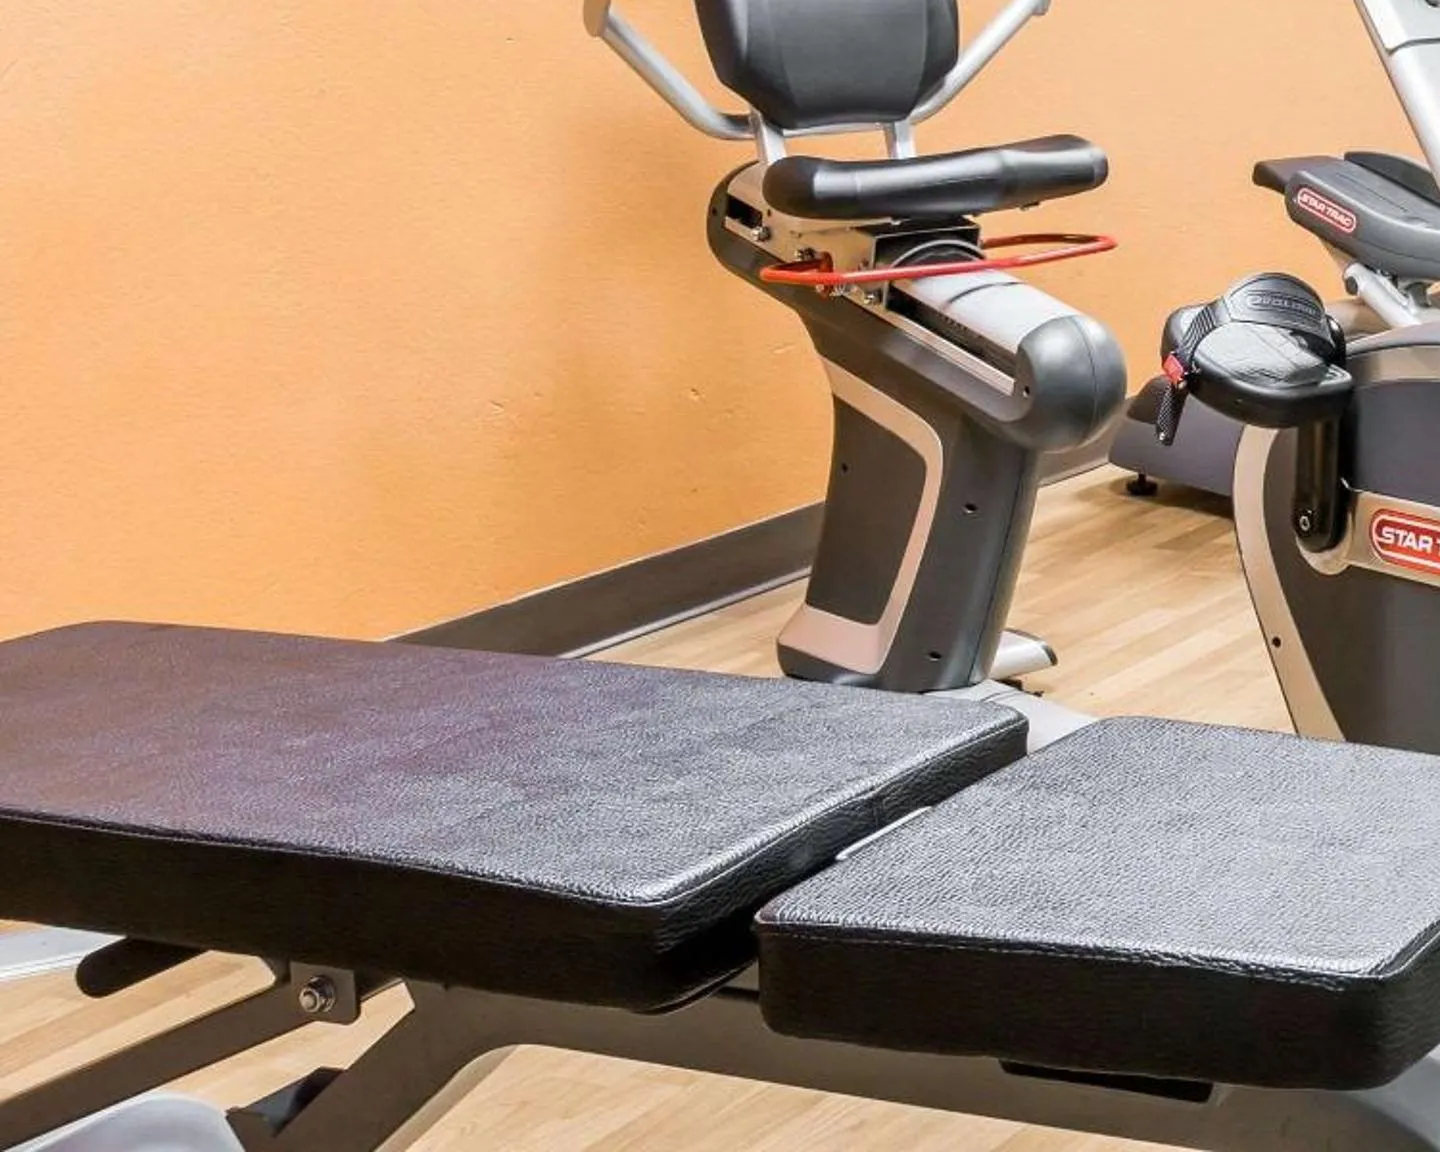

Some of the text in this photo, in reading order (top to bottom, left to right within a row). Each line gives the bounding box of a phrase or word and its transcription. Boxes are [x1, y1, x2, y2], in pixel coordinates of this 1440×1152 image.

[1301, 193, 1353, 227] STAR TRAC
[1379, 527, 1433, 553] STAR
